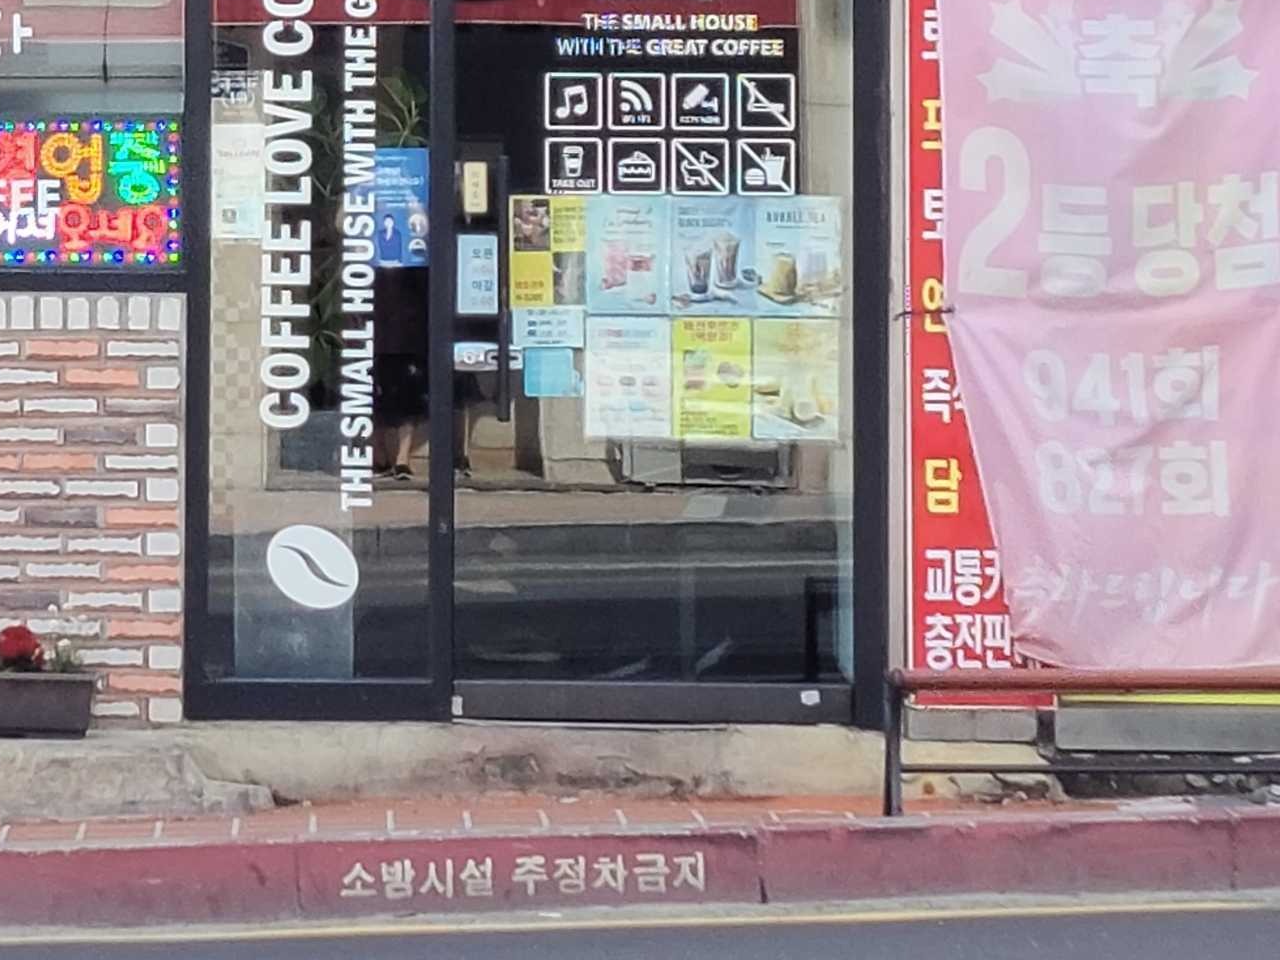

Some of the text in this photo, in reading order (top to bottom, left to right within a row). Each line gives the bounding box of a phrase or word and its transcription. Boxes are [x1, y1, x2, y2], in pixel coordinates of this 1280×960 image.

[343, 26, 379, 92] THE
[556, 37, 785, 56] WITH THE GREAT COFFEE
[582, 13, 759, 31] THE SMALL HOUSE
[1078, 13, 1162, 109] 축
[261, 69, 314, 205] LOVE
[343, 99, 377, 187] WITH
[341, 191, 376, 313] HOUSE
[957, 126, 1279, 300] 2등 당첨
[259, 220, 313, 430] COFFEE
[340, 319, 375, 441] SMALL
[1021, 345, 1220, 427] 941회
[340, 445, 374, 514] THE
[923, 613, 1016, 672] 충전판
[339, 851, 707, 900] 소방시설 주정차금지
